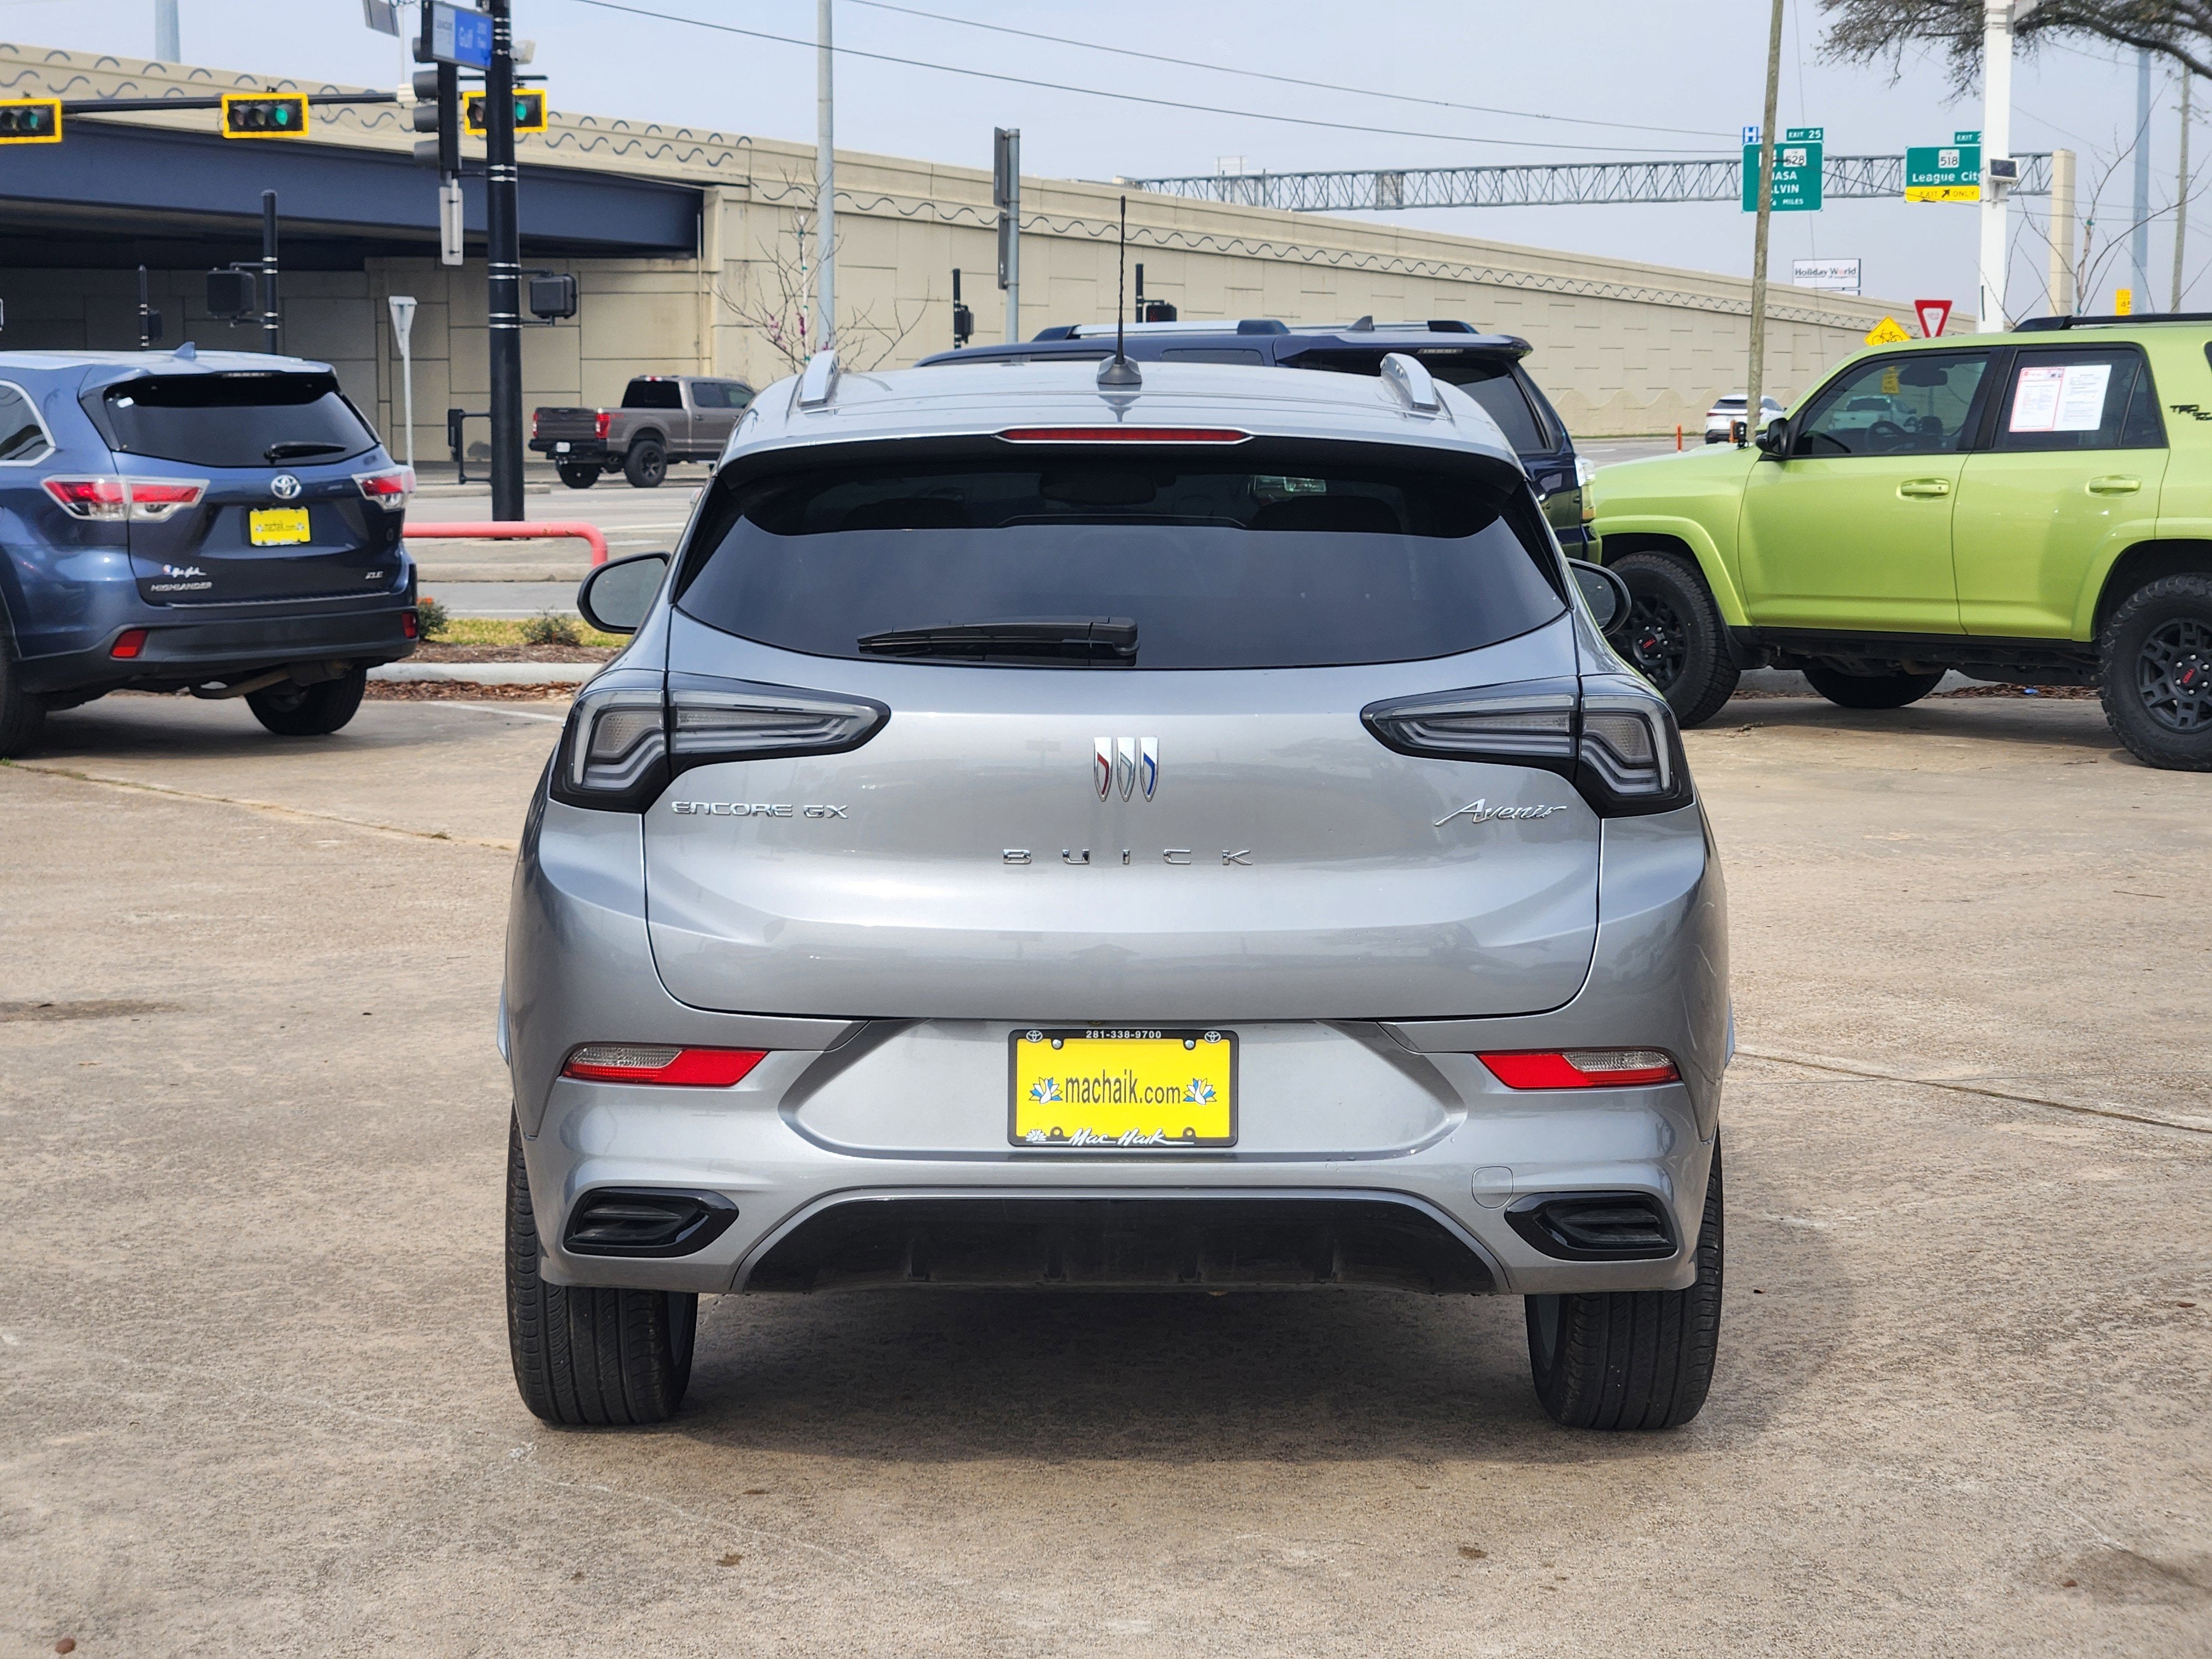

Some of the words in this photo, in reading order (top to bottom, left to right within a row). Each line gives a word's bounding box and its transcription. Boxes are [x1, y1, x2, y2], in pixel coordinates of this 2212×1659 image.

[1808, 129, 1821, 139] 25
[1786, 155, 1804, 165] 528
[1940, 156, 1958, 166] 518
[1912, 173, 1955, 184] League
[1771, 184, 1799, 194] LVIN
[1795, 268, 1828, 277] Holiday
[150, 581, 212, 592] HIGHLANDER
[671, 801, 793, 817] ENCORE
[803, 804, 849, 820] GX
[1433, 798, 1567, 827] Avenir
[1002, 848, 1253, 866] BUICK
[1086, 1030, 1162, 1039] 281-338-9700
[1065, 1069, 1181, 1104] machaik.com
[1069, 1128, 1115, 1146] Mac
[1117, 1128, 1171, 1146] Haik
